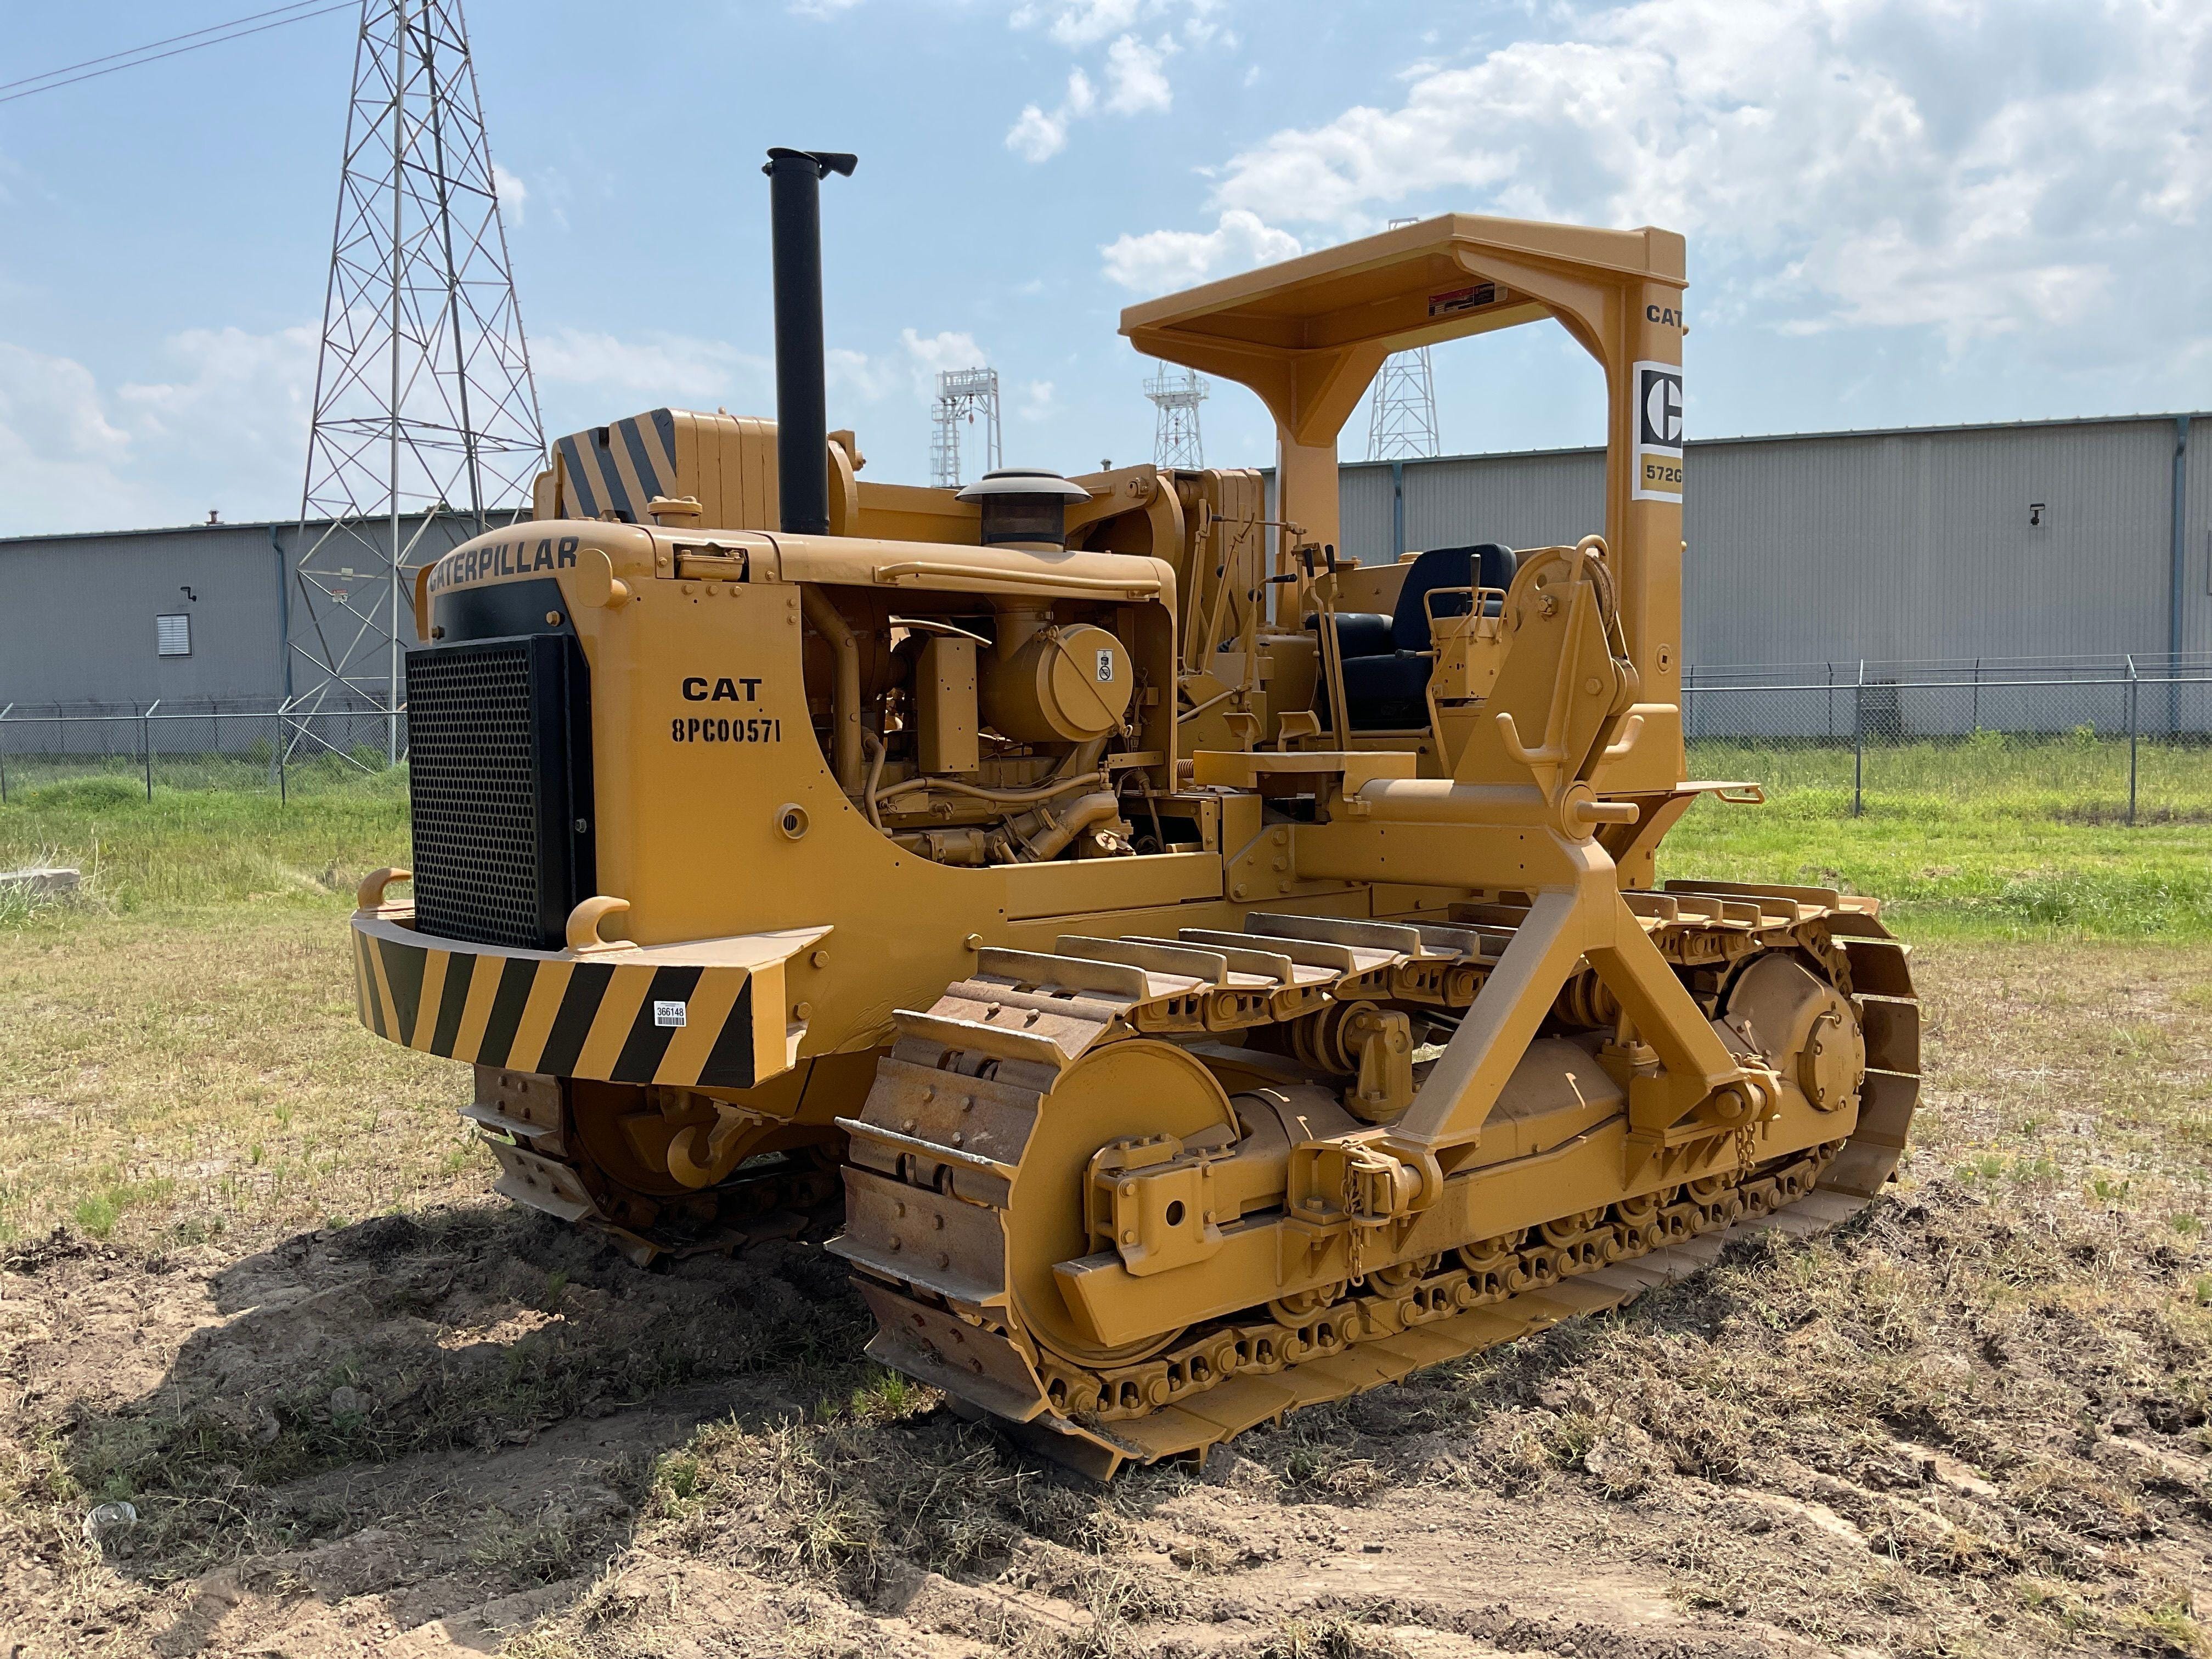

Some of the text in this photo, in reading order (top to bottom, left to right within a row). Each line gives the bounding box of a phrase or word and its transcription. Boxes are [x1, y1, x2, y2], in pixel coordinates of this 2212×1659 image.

[1647, 304, 1683, 328] CAT
[1646, 465, 1682, 483] 572G
[430, 536, 579, 591] CATERPILLAR
[682, 677, 762, 702] CAT
[657, 1007, 684, 1017] 366148
